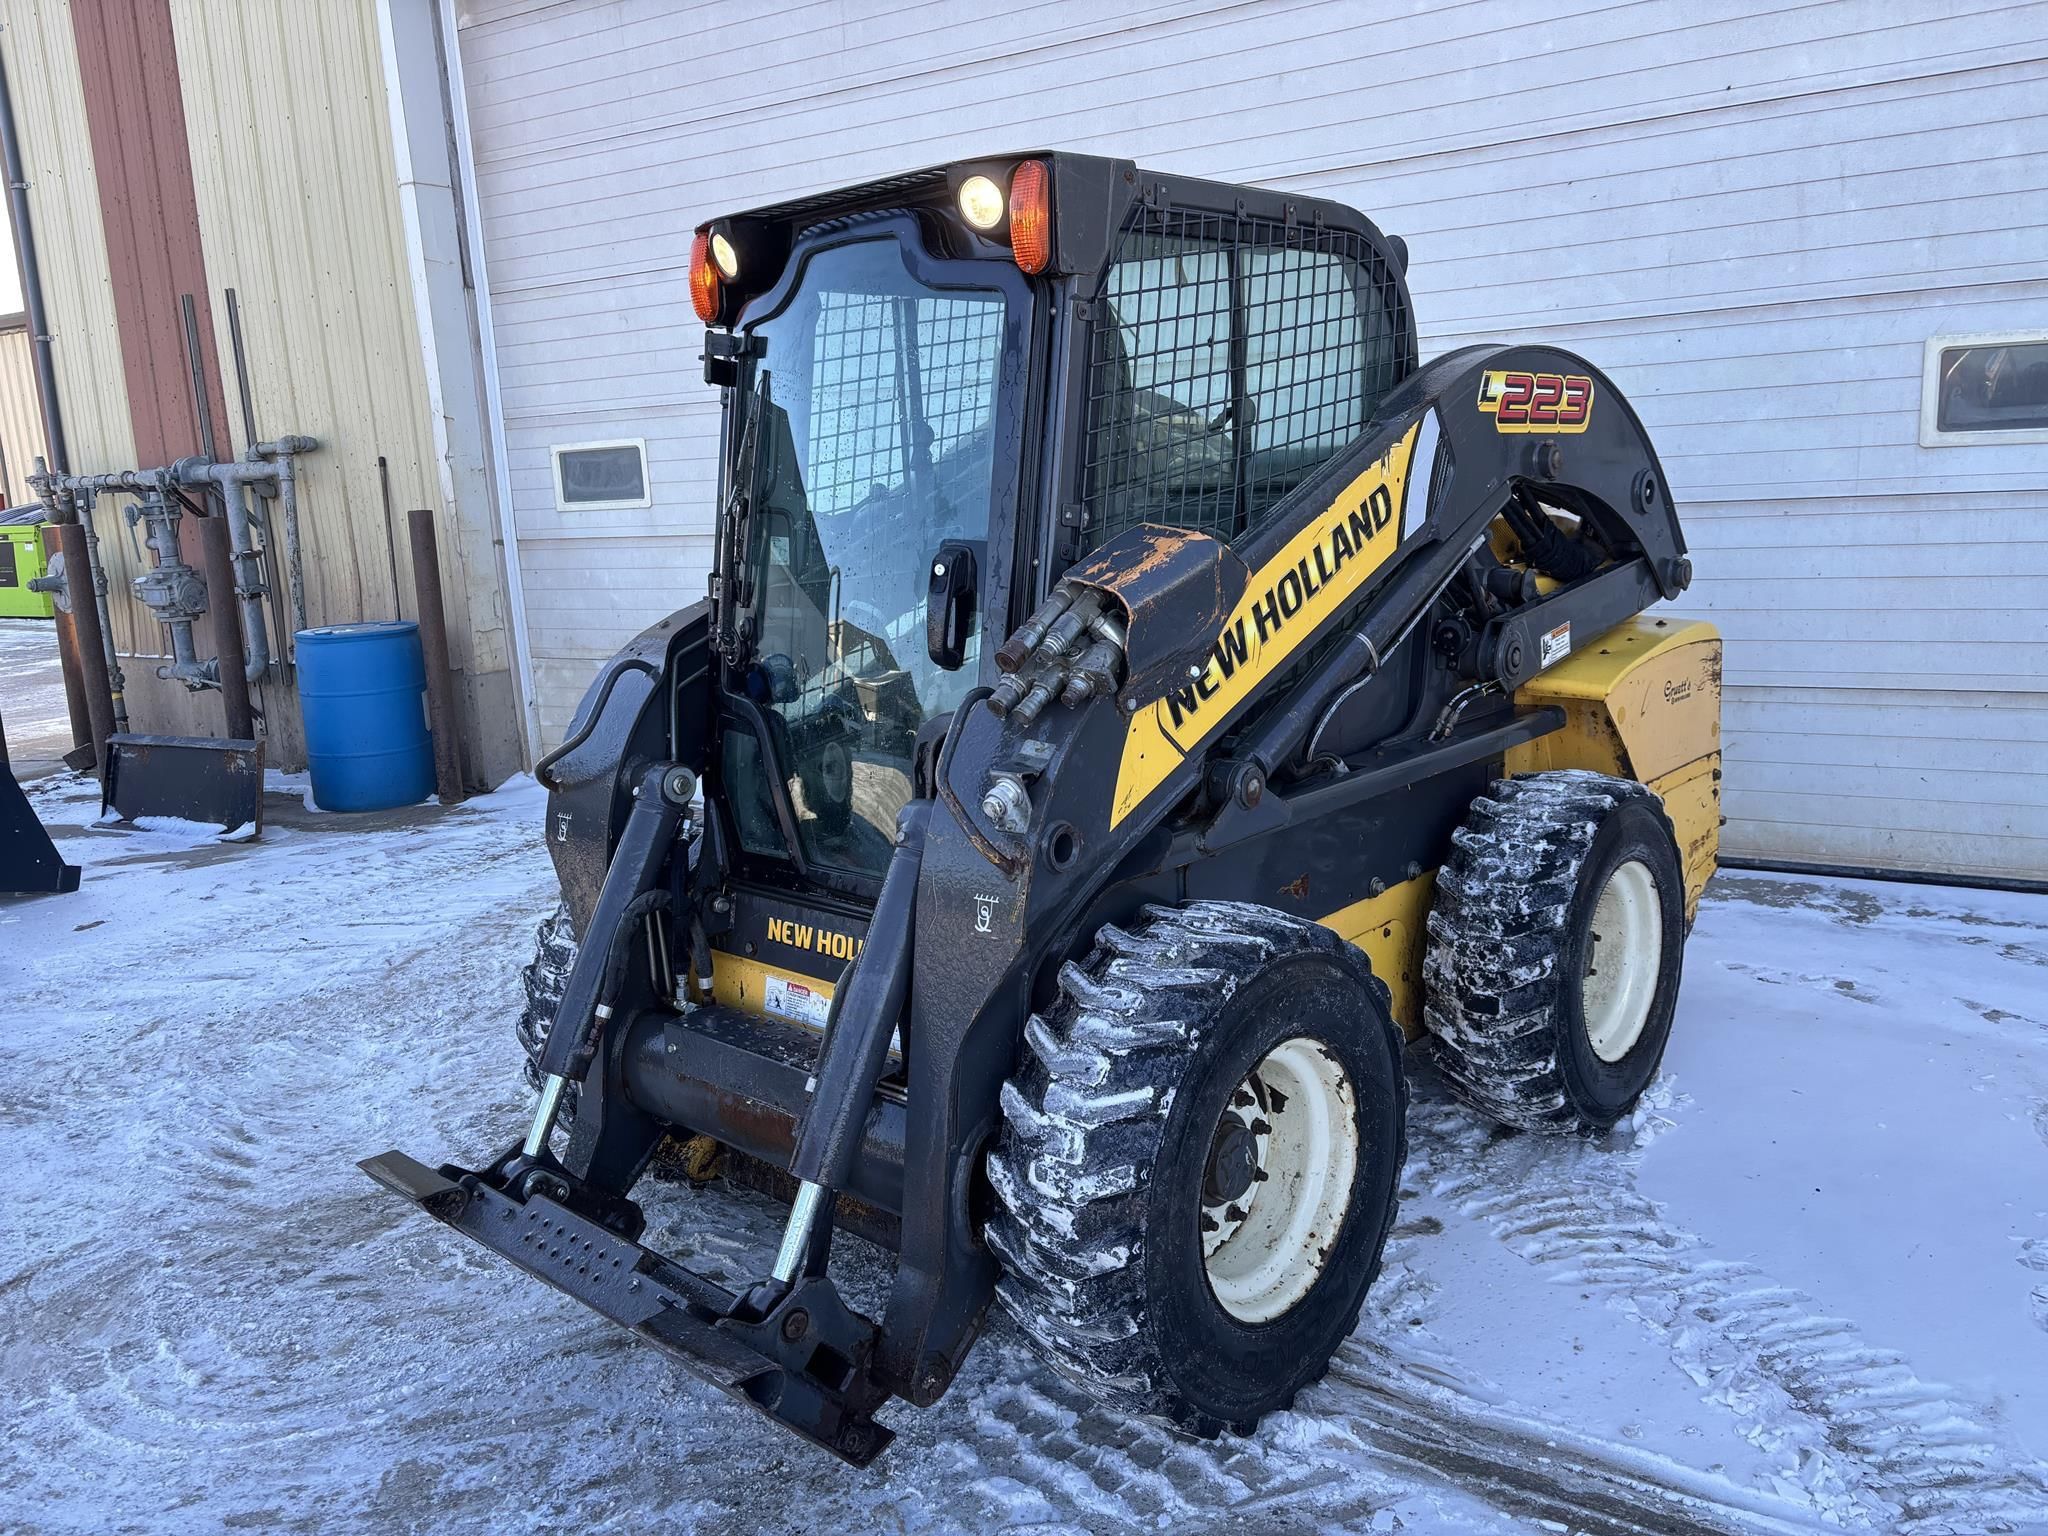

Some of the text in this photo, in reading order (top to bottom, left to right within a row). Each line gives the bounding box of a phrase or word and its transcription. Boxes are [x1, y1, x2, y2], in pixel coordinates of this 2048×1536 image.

[1478, 371, 1592, 429] L223
[1164, 482, 1393, 730] NEW HOLLAND
[767, 917, 814, 950] NEW
